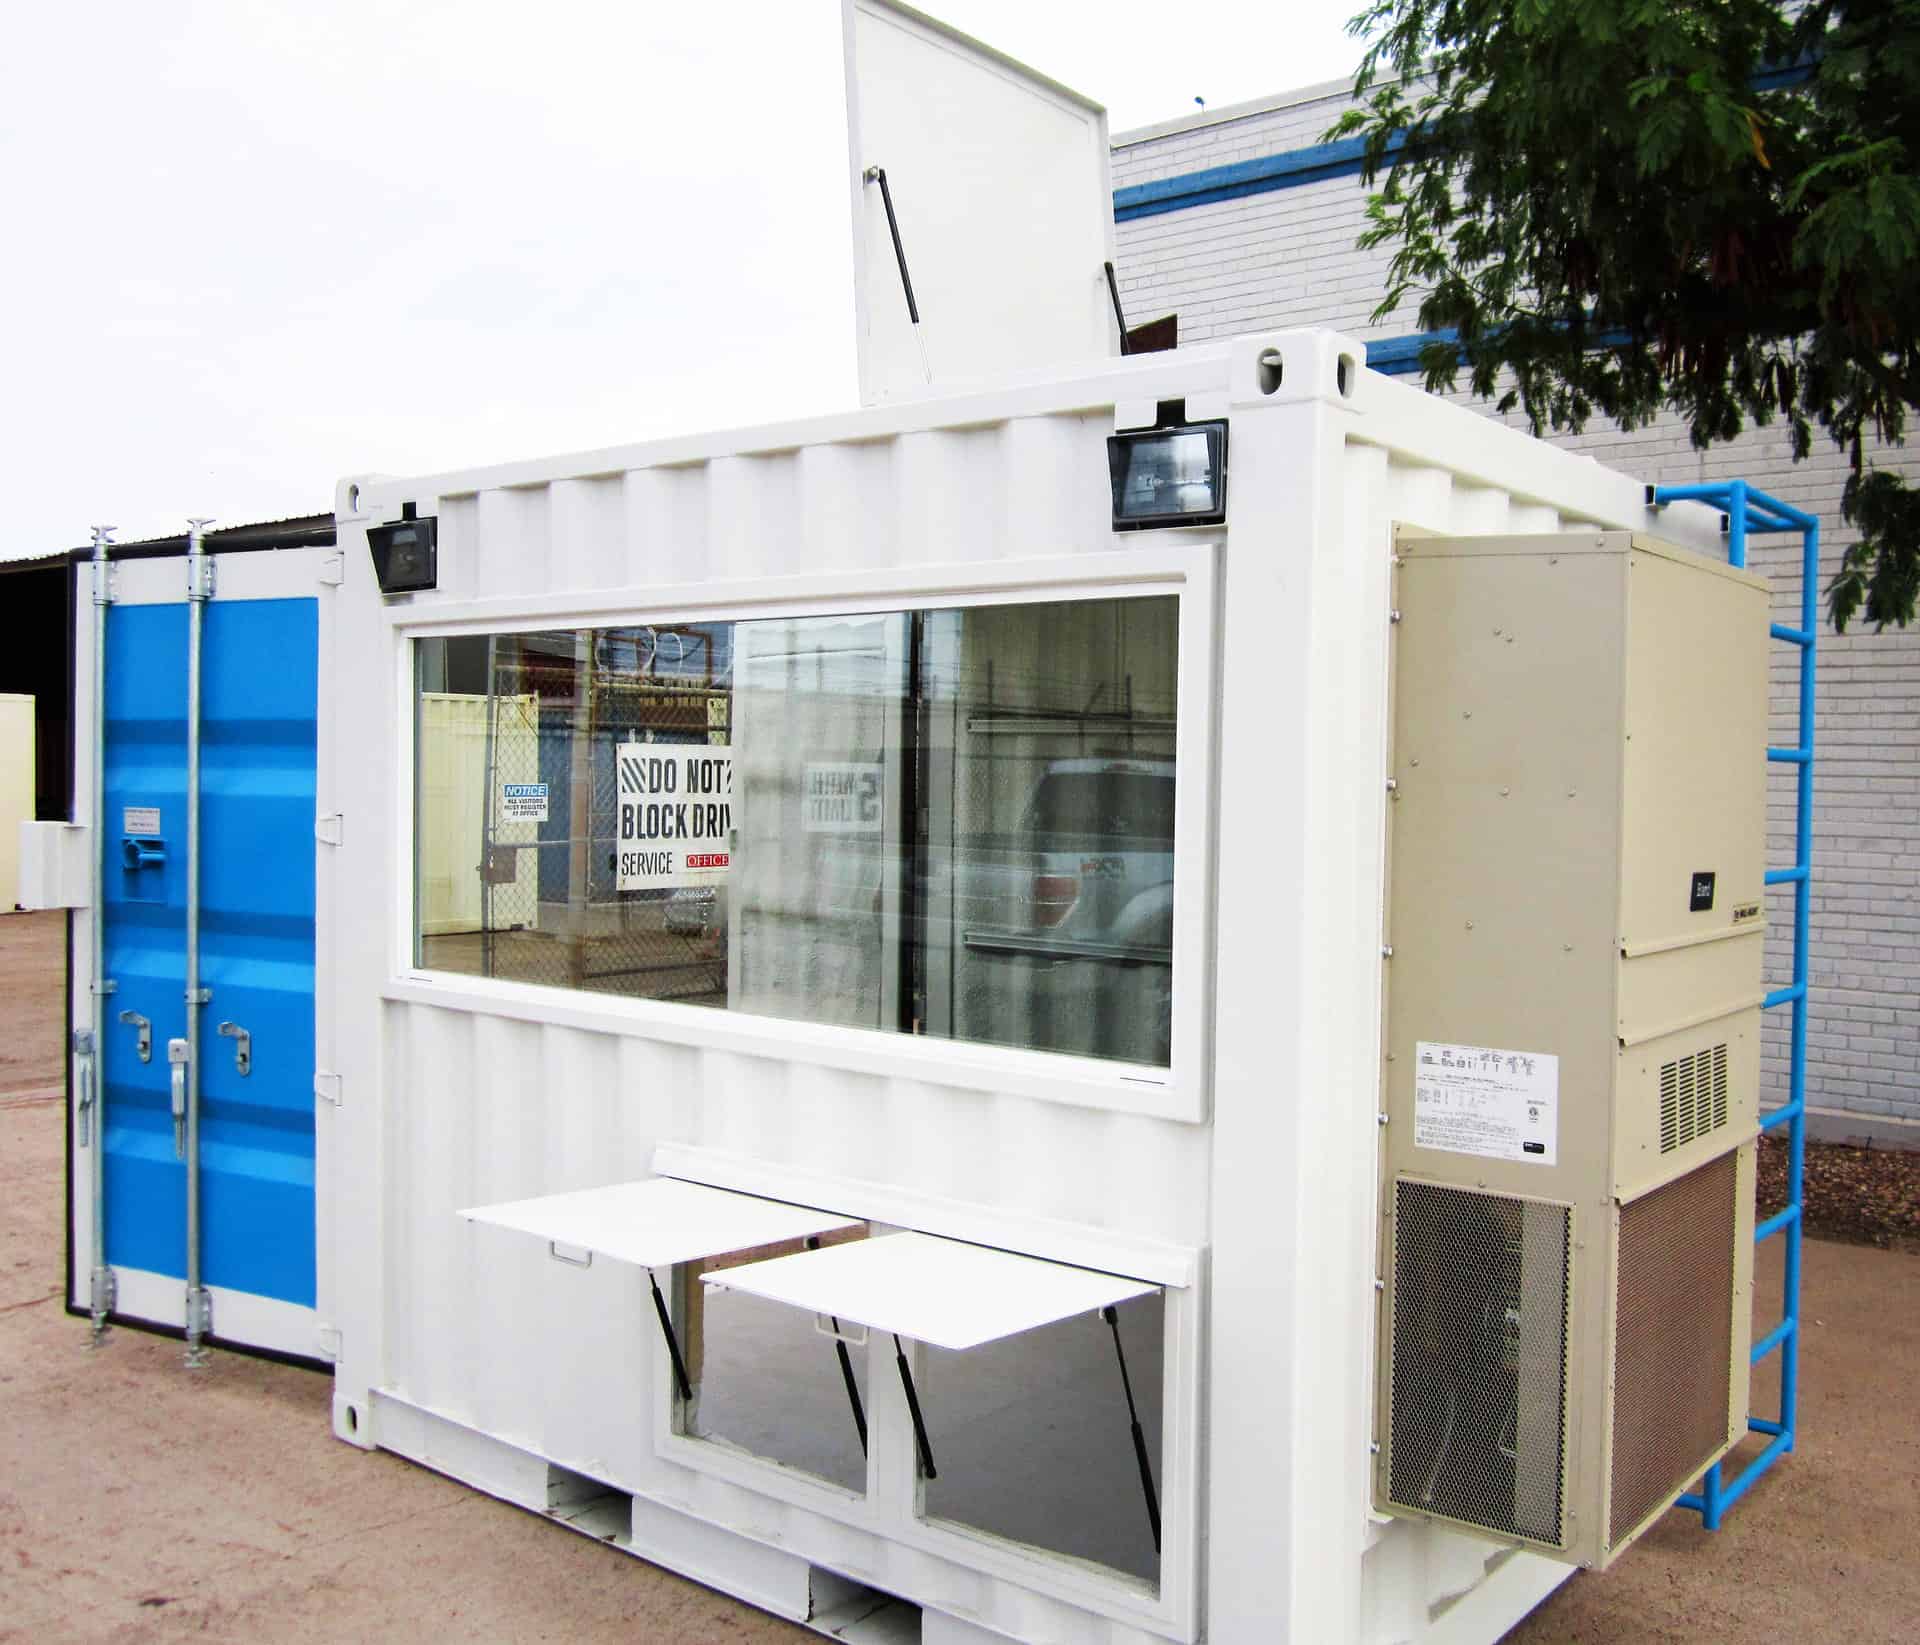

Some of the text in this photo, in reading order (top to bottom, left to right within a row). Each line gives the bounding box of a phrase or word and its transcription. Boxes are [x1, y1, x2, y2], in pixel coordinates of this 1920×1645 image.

[506, 785, 545, 796] NOTICE
[648, 758, 725, 794] DO NOT
[621, 803, 688, 839] BLOCK
[621, 851, 729, 876] SERVICE OFFICE
